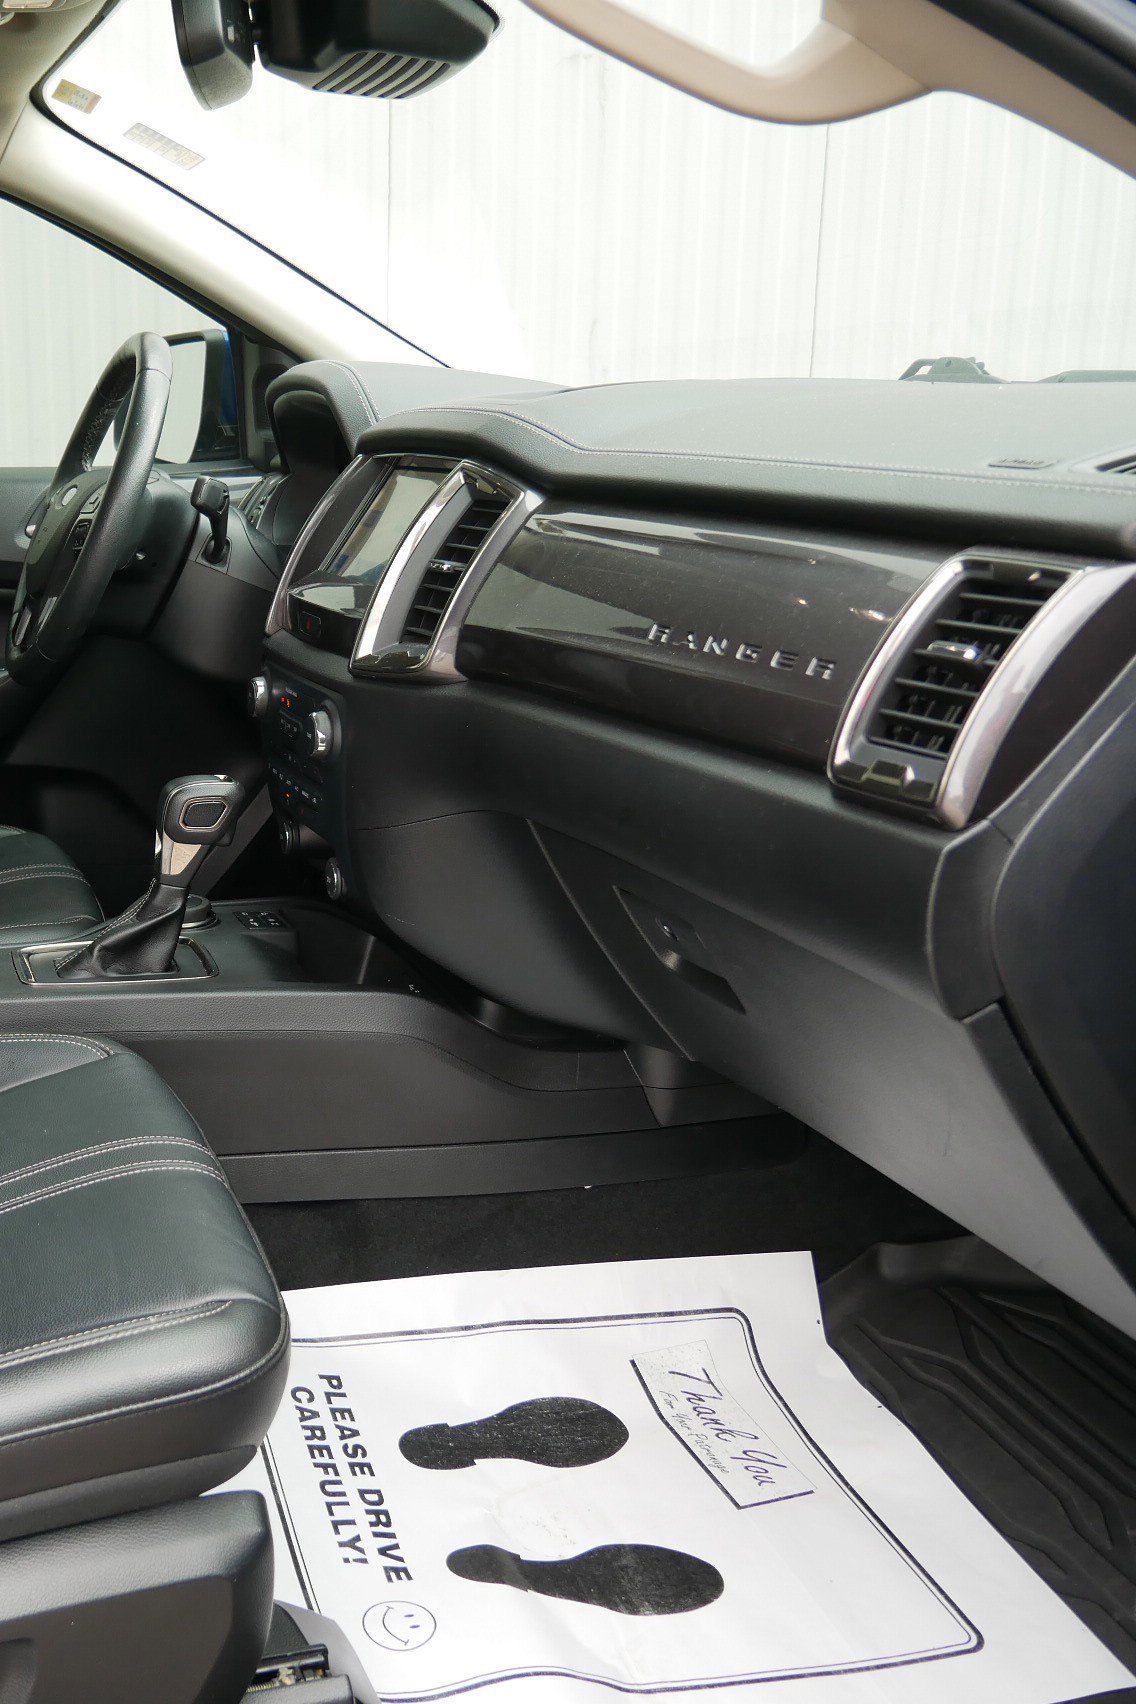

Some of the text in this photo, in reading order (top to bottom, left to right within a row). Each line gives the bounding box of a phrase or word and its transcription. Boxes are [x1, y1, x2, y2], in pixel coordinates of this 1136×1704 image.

[647, 622, 837, 681] RANGER
[659, 1390, 679, 1411] For
[667, 1367, 787, 1487] Thank You
[290, 1386, 369, 1564] CAREFULLY!
[318, 1373, 414, 1583] PLEASE DRIVE
